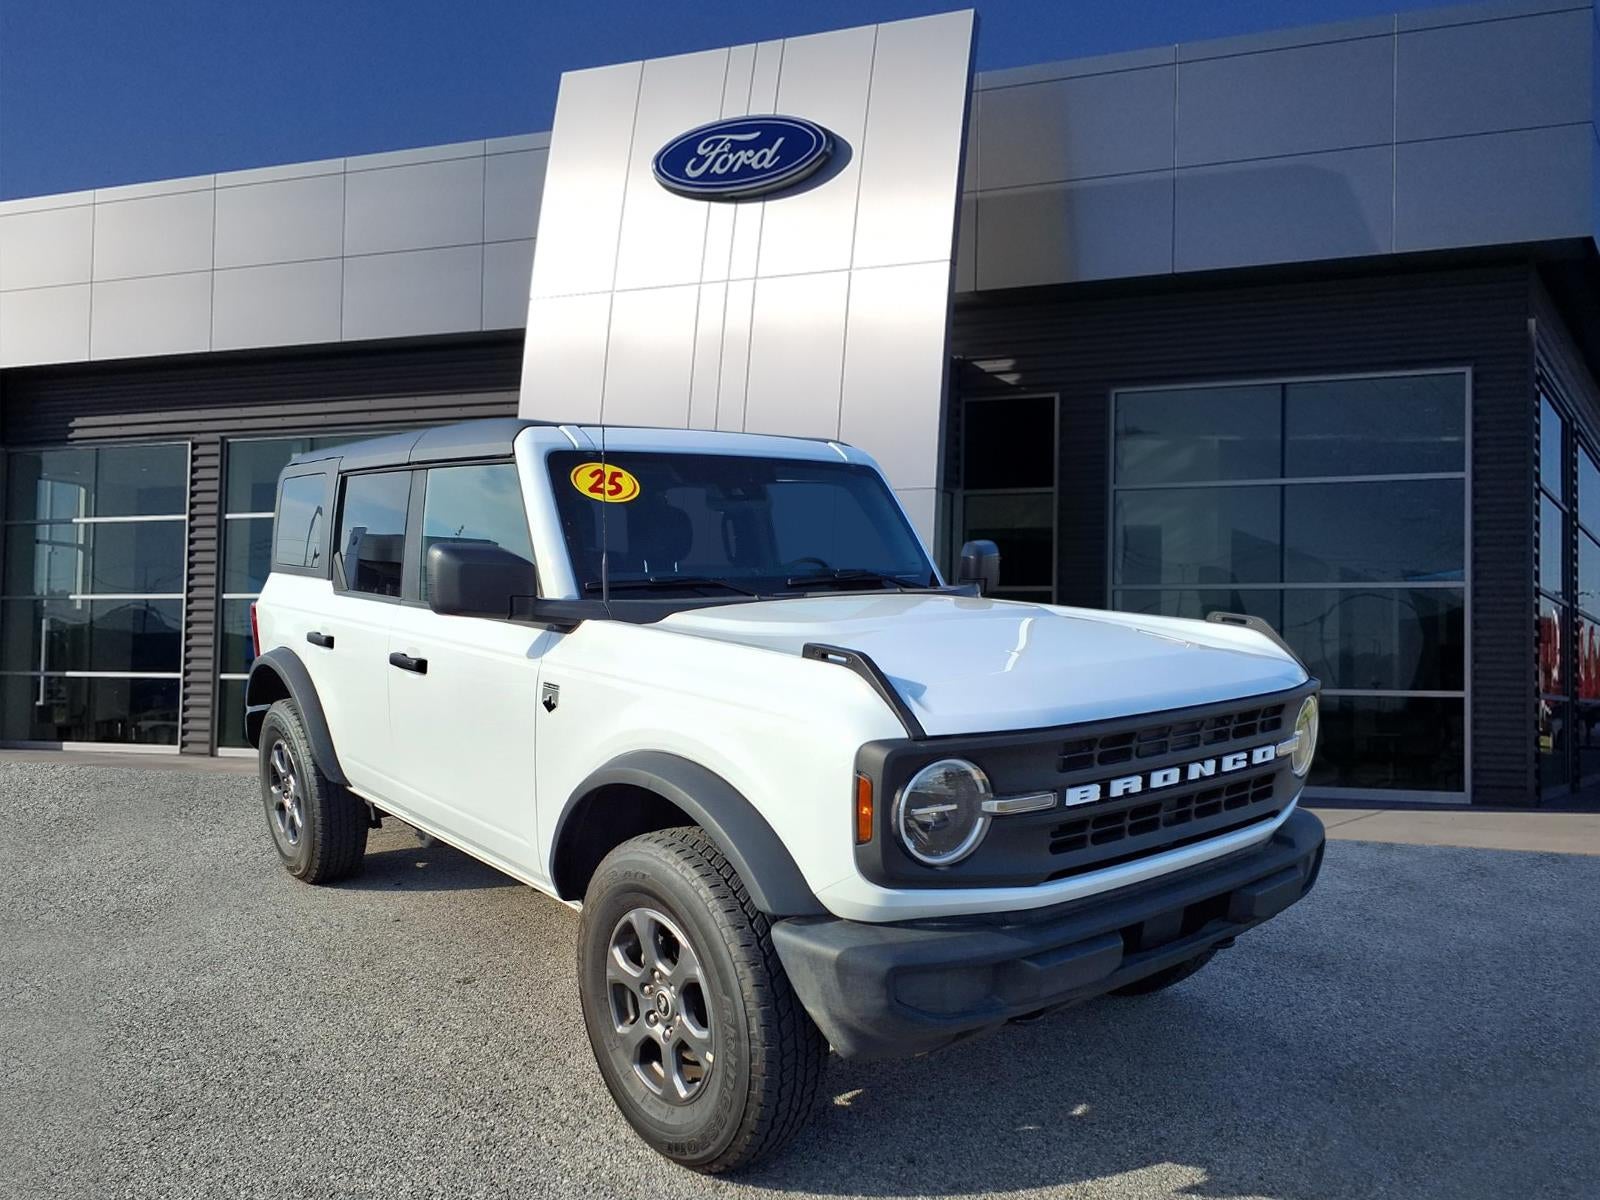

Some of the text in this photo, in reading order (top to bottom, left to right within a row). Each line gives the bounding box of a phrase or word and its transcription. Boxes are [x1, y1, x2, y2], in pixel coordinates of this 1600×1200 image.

[685, 131, 784, 178] Ford
[588, 468, 623, 496] 25
[1065, 744, 1276, 807] BRONCO
